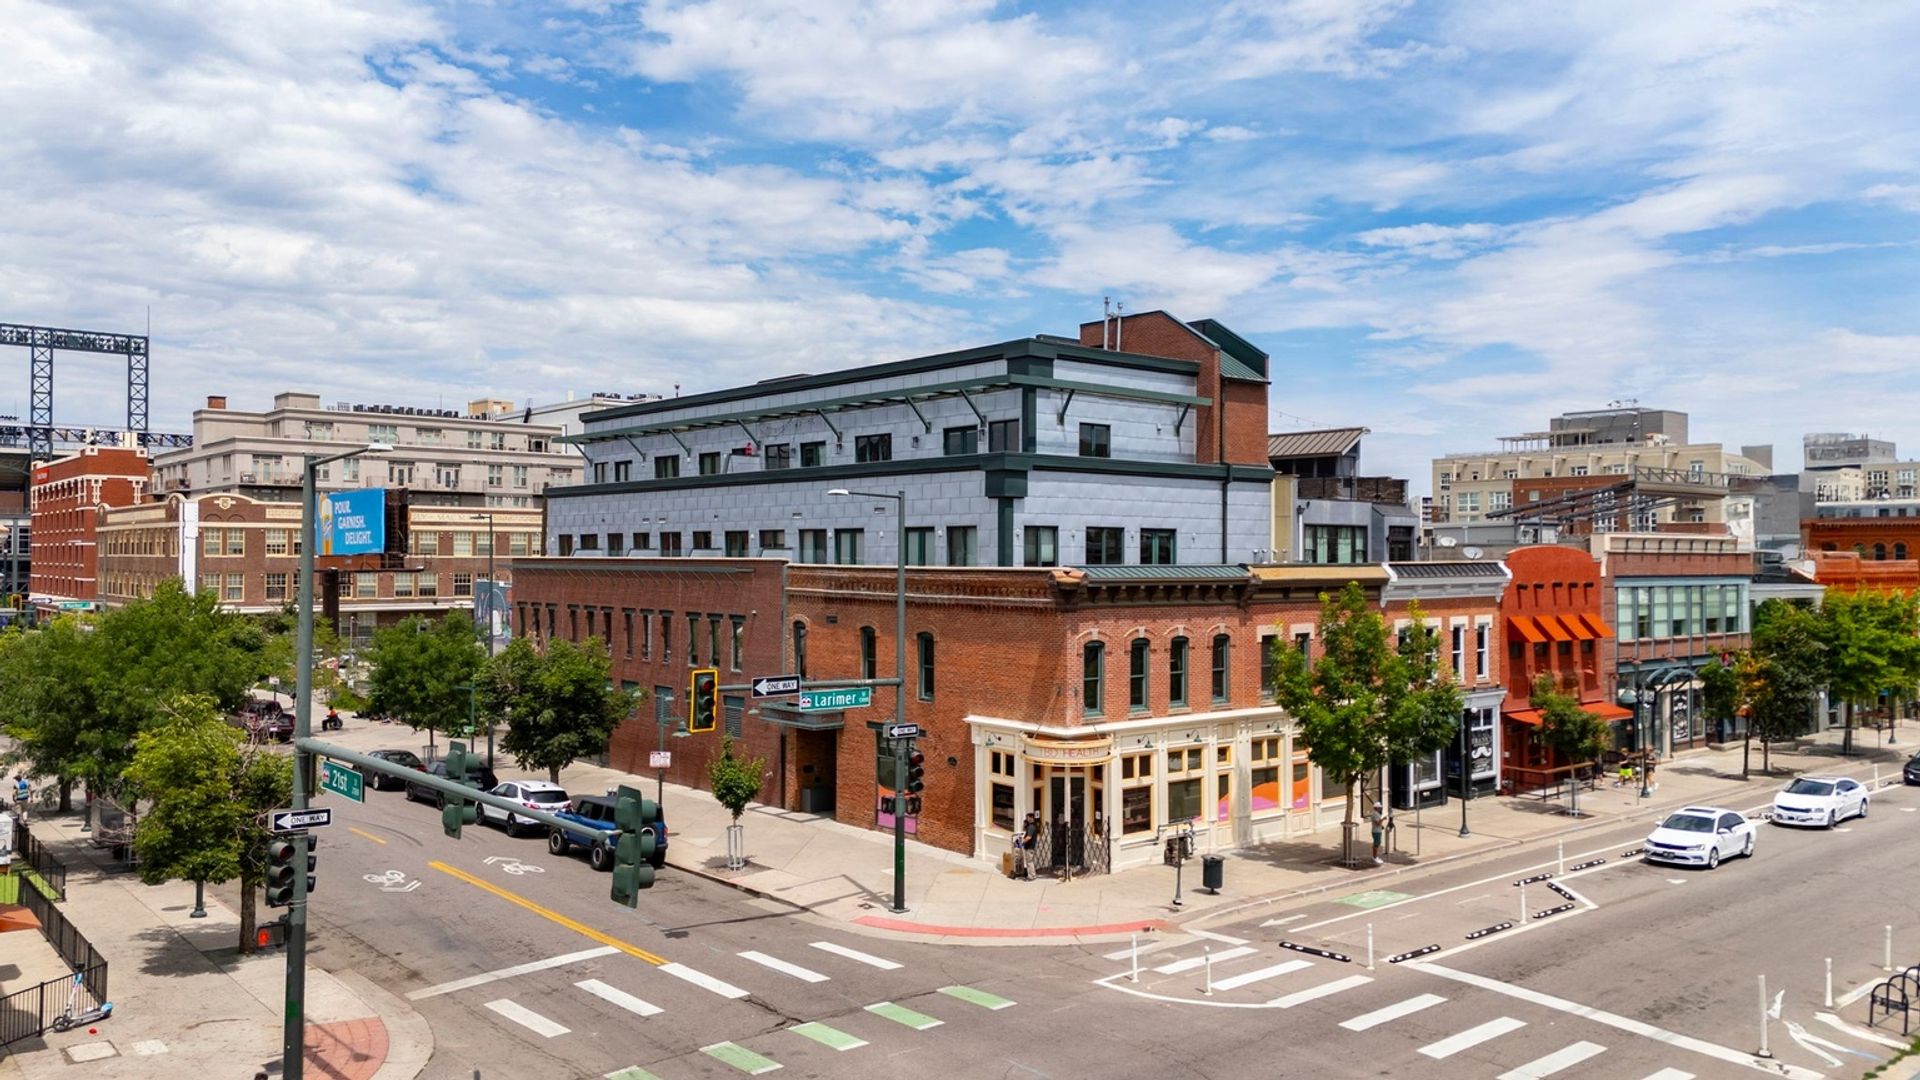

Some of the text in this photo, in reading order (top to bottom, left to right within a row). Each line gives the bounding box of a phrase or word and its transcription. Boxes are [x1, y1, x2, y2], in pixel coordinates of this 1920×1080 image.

[334, 500, 351, 514] POUR.
[338, 515, 366, 529] GARNISH.
[345, 531, 372, 545] DELIGHT.
[767, 681, 796, 691] ONE WAY
[815, 692, 856, 707] Larimer
[332, 770, 348, 792] 21st
[291, 814, 325, 824] ONE WAY
